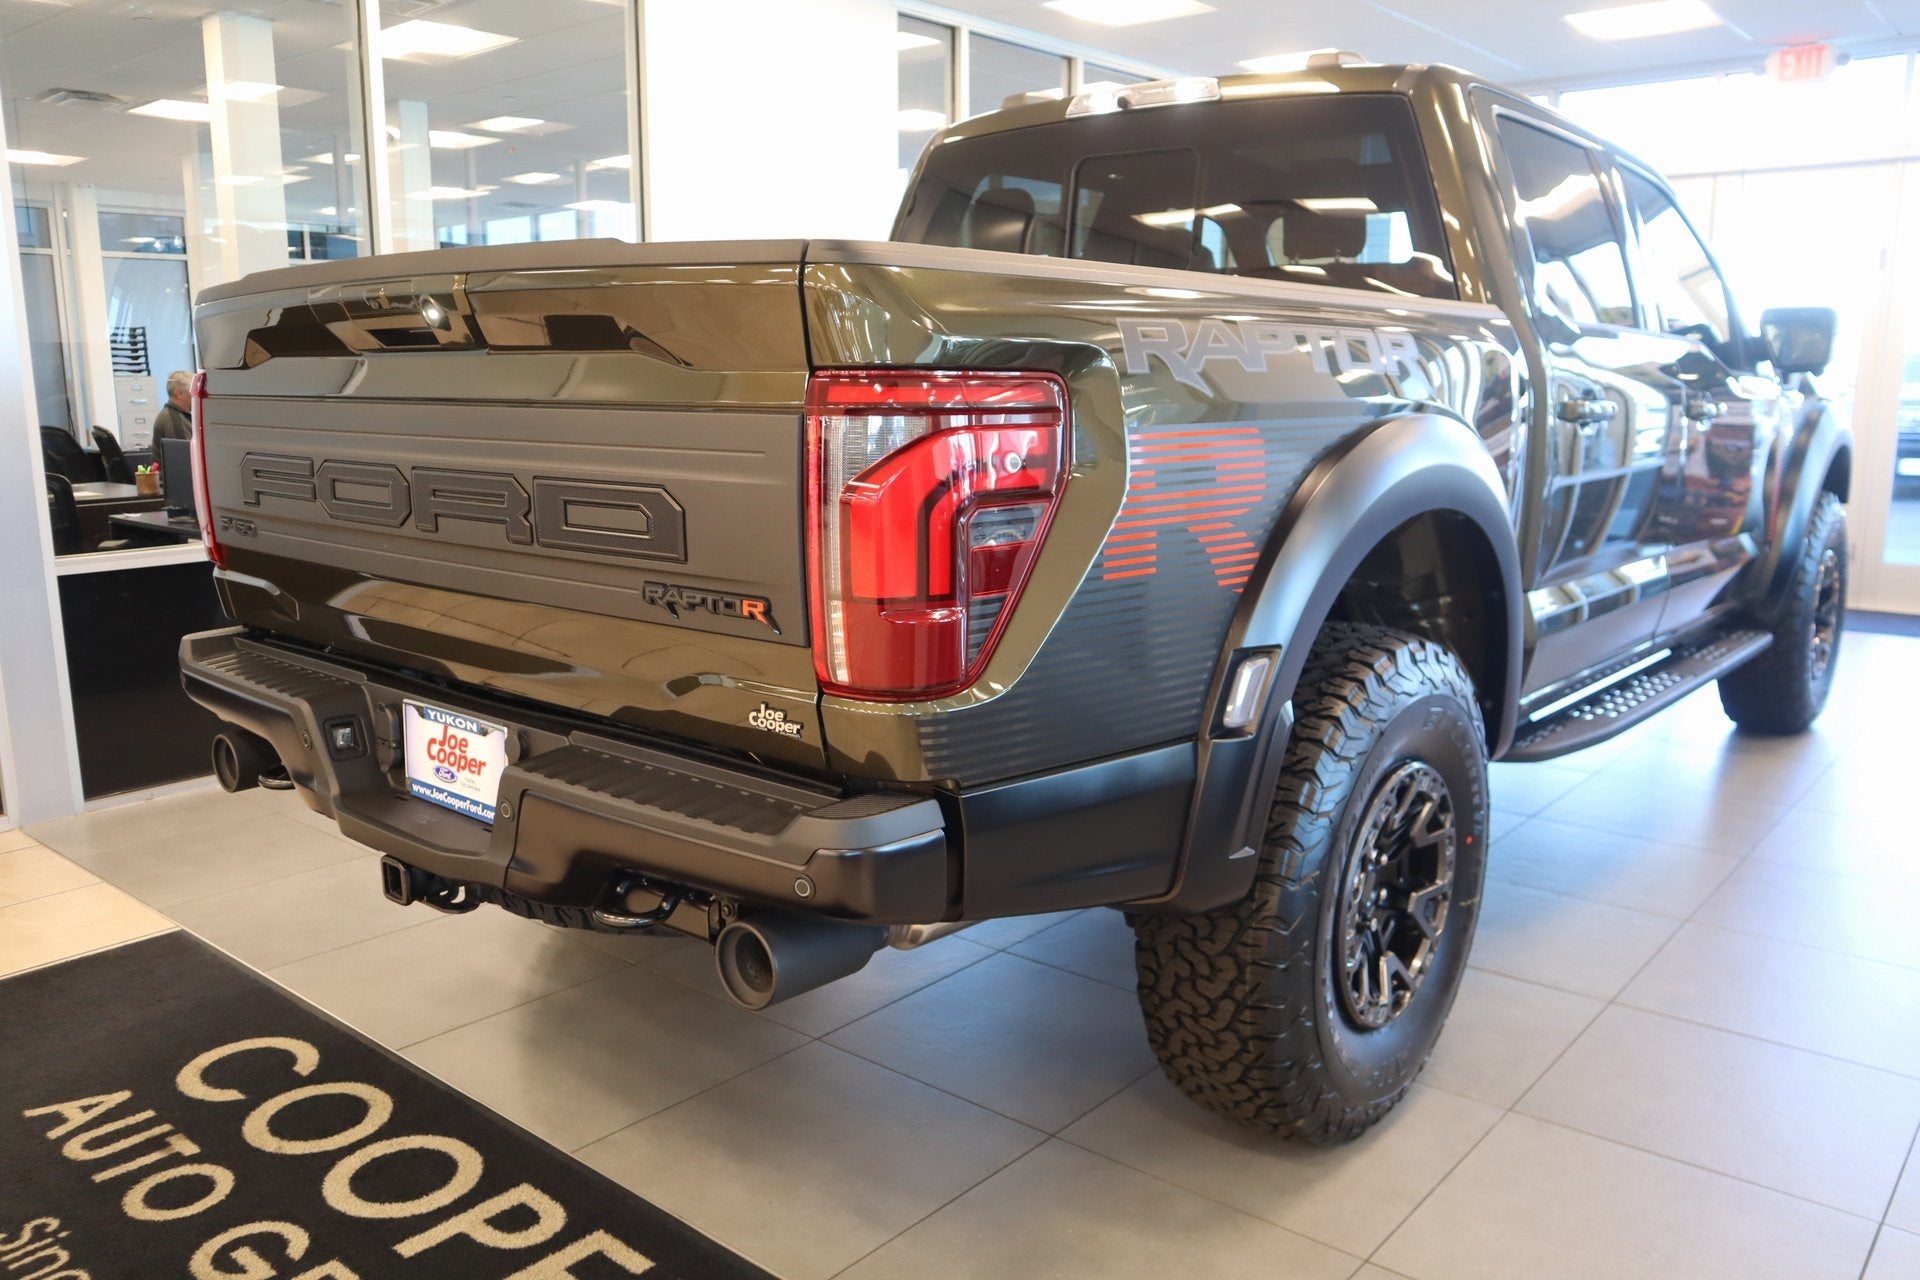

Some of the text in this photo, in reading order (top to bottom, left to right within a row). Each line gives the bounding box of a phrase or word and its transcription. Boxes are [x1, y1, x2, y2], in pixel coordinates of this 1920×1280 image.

[1778, 44, 1827, 82] EXIT
[1116, 316, 1438, 401] RAPTOR
[239, 451, 689, 565] FORD
[642, 580, 783, 636] RAPTOR
[426, 708, 479, 733] YUKON
[748, 710, 802, 735] Cooper
[757, 702, 785, 721] Joe
[426, 737, 487, 776] Cooper
[438, 724, 469, 754] Joe
[23, 1089, 235, 1222] AUTO
